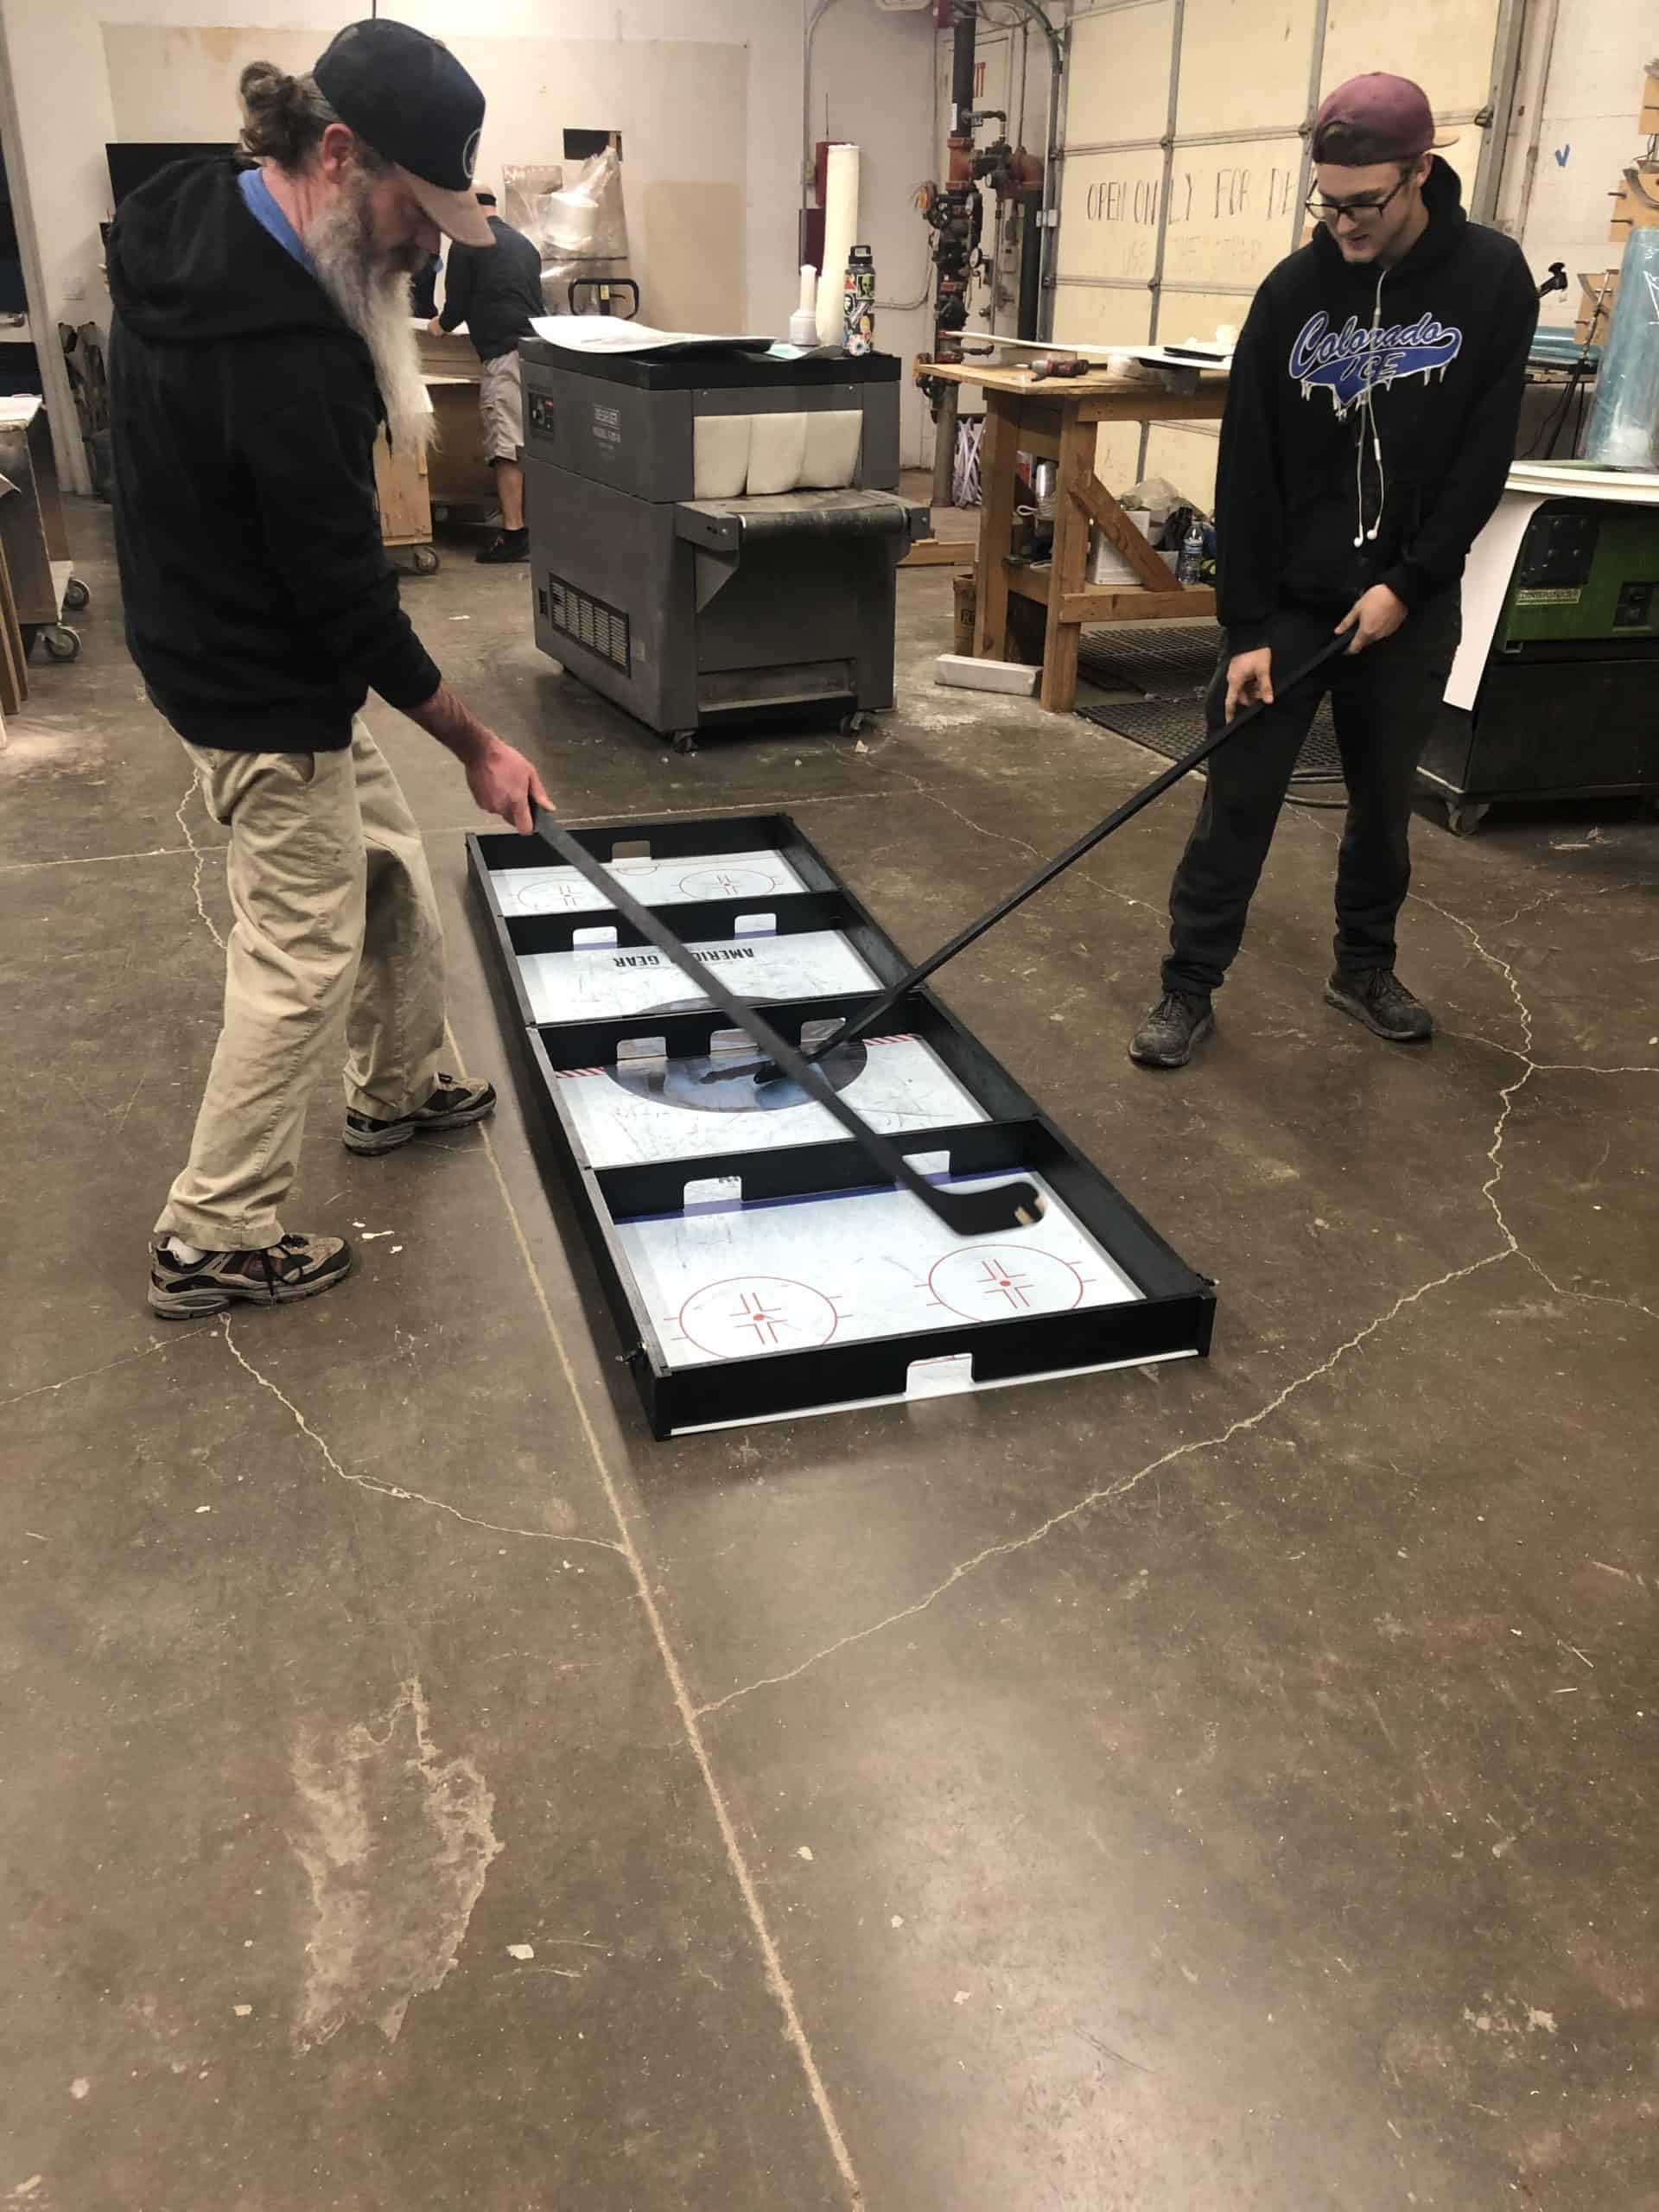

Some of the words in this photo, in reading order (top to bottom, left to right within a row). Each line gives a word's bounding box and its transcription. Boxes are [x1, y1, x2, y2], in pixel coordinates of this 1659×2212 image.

[1087, 181, 1126, 221] OPEN
[1134, 172, 1192, 226] ONLY
[1213, 168, 1250, 219] FOR
[1266, 168, 1295, 221] DE
[1289, 311, 1446, 378] Colorado
[613, 955, 661, 968] GEAR
[690, 947, 754, 963] AMERIC
